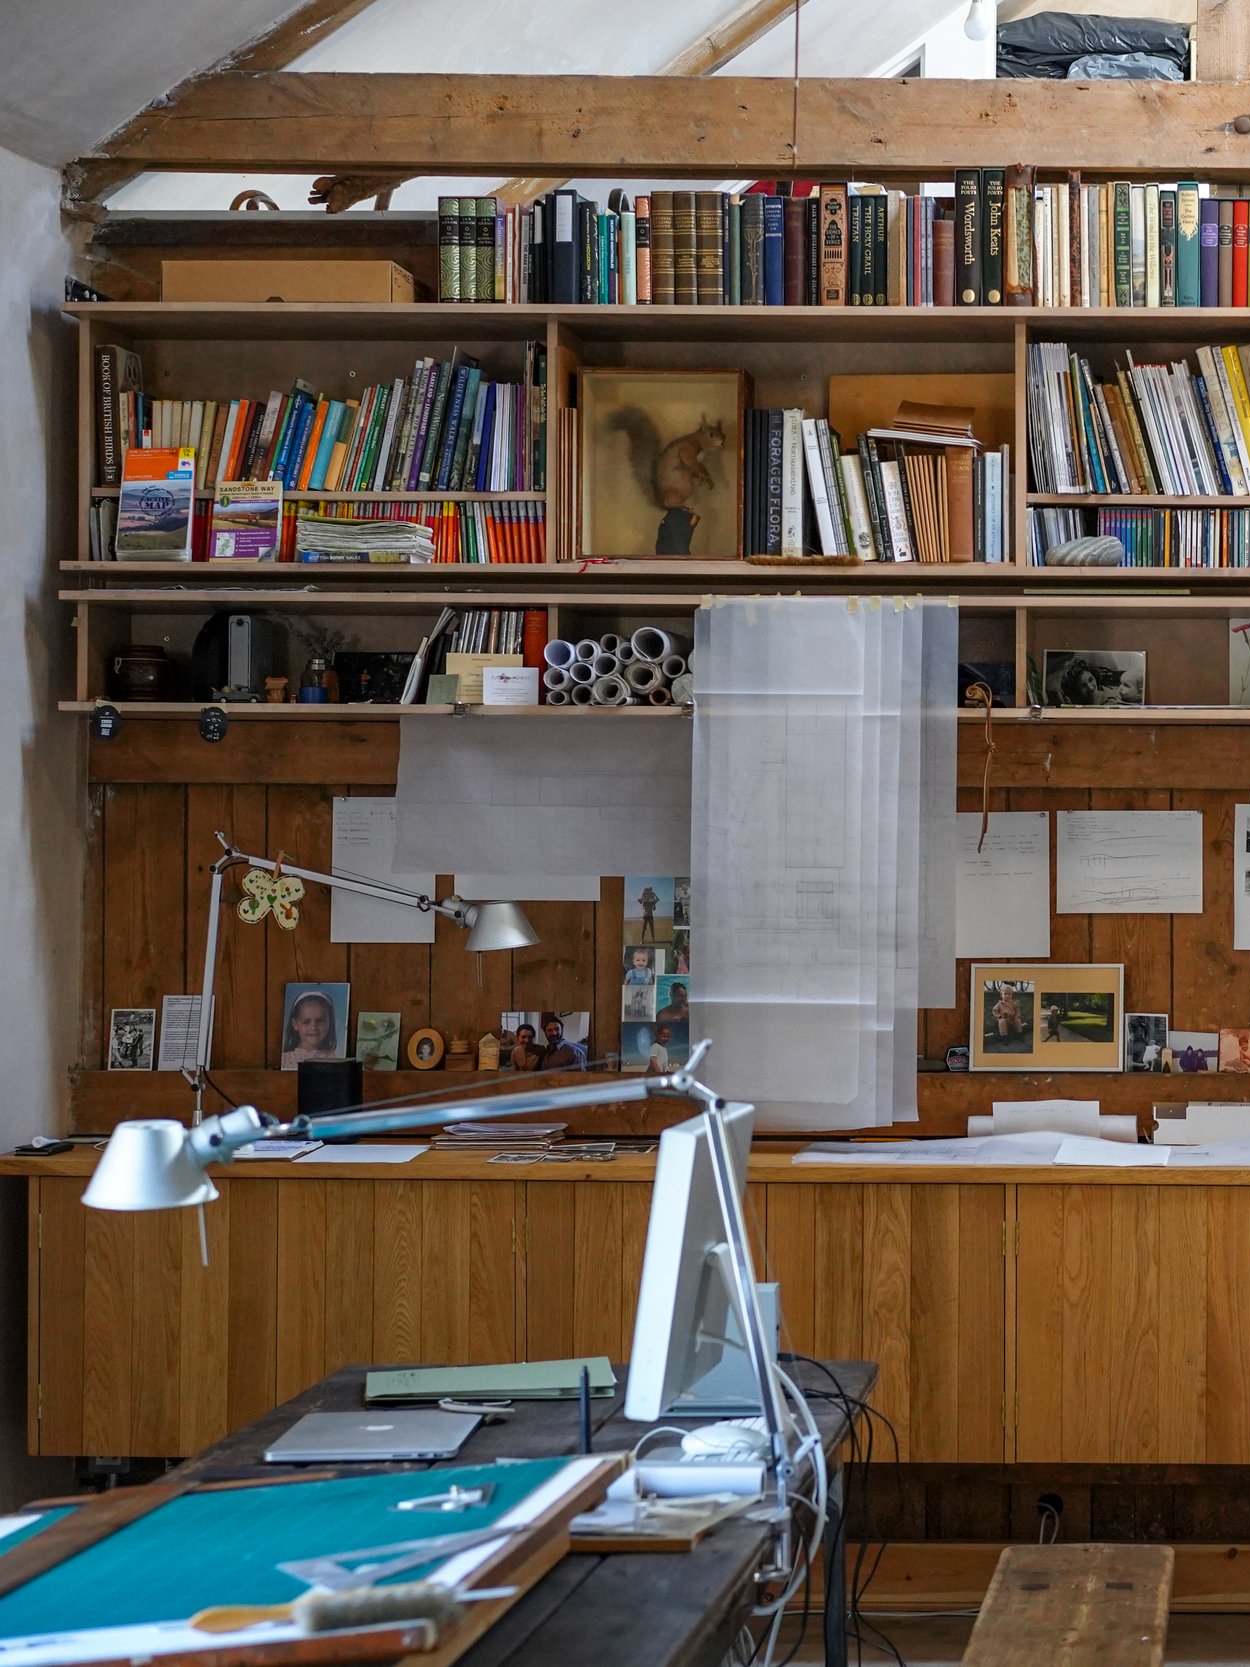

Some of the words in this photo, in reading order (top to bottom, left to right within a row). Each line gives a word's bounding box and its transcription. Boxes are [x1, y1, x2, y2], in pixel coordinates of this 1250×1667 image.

[852, 206, 860, 242] TRISTAN
[864, 206, 872, 224] THE
[877, 206, 885, 242] ARTHUR
[990, 201, 1001, 226] John
[864, 226, 872, 248] HOLY
[964, 202, 975, 265] Wordsworth
[990, 228, 1001, 256] Keats
[864, 250, 872, 275] GRAIL
[102, 355, 112, 382] BOOK
[103, 382, 112, 395] OF
[452, 368, 467, 418] WILDERNESS
[104, 396, 113, 434] BRITISH
[447, 419, 458, 446] WALKS
[105, 436, 114, 465] BIRDS
[770, 430, 781, 494] FORAGED
[144, 501, 171, 510] MAP
